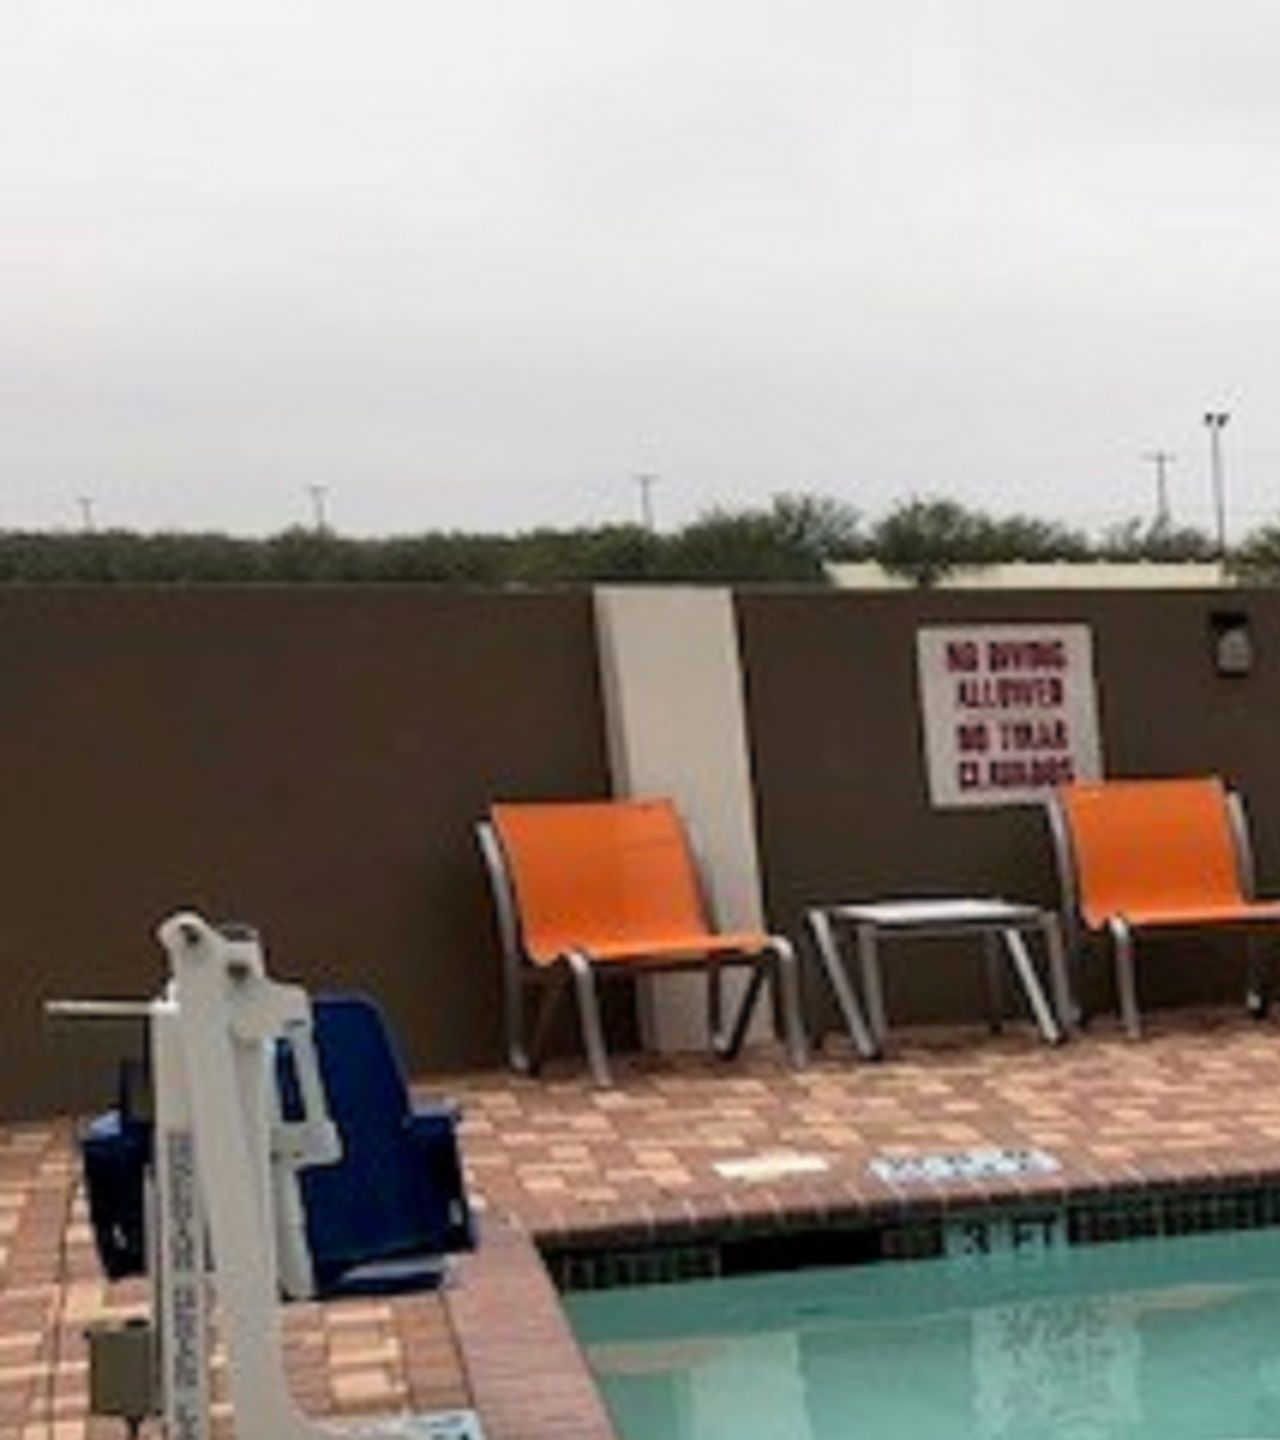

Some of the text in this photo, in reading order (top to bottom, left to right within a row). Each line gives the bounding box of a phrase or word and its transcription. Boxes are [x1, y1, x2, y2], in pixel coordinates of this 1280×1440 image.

[947, 640, 1067, 671] NO DIVING
[957, 677, 1062, 708] ALLOWED
[958, 723, 988, 751] NO
